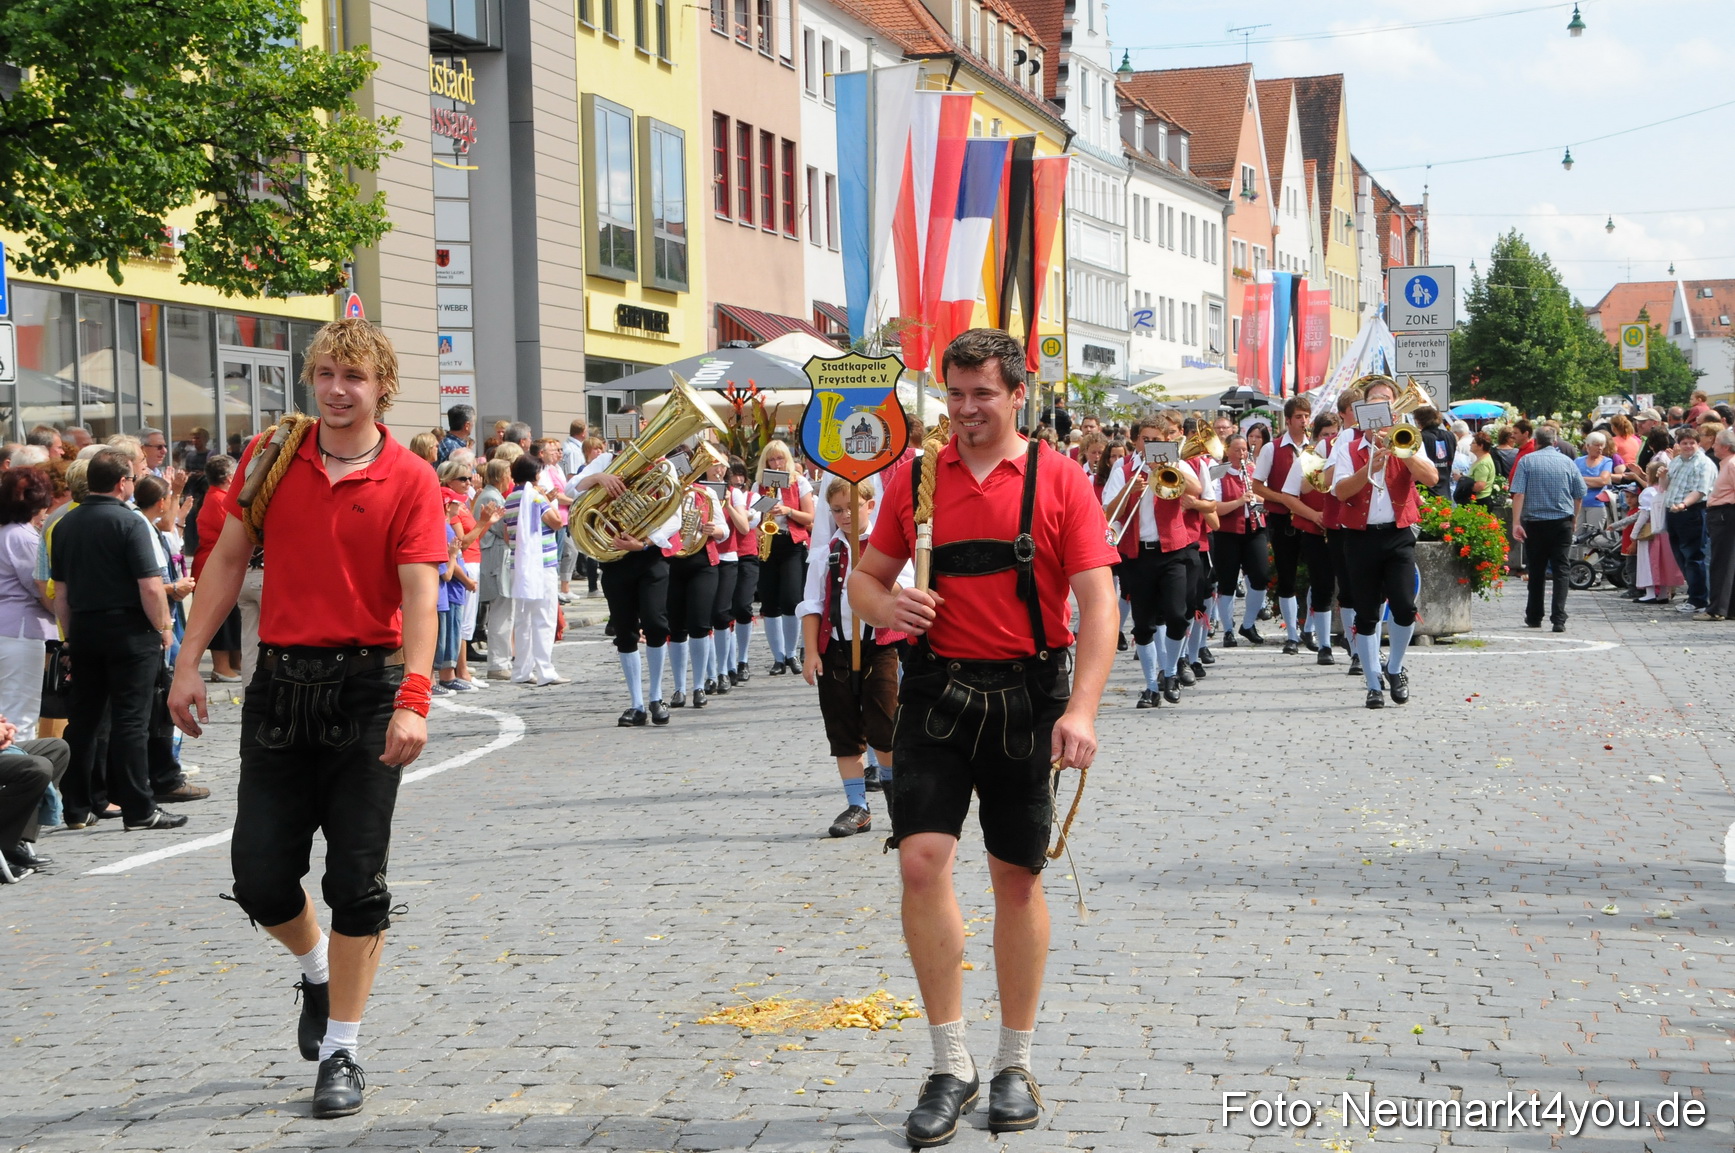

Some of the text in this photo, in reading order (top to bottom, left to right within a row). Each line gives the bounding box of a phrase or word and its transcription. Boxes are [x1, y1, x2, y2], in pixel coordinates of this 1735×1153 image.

[1405, 315, 1438, 330] ZONE
[1397, 339, 1446, 348] Lieferverkehr
[821, 362, 886, 372] Stadtkapelle
[1416, 360, 1429, 368] frei
[818, 374, 889, 385] Freystadt e.V.
[440, 385, 469, 395] HAARE
